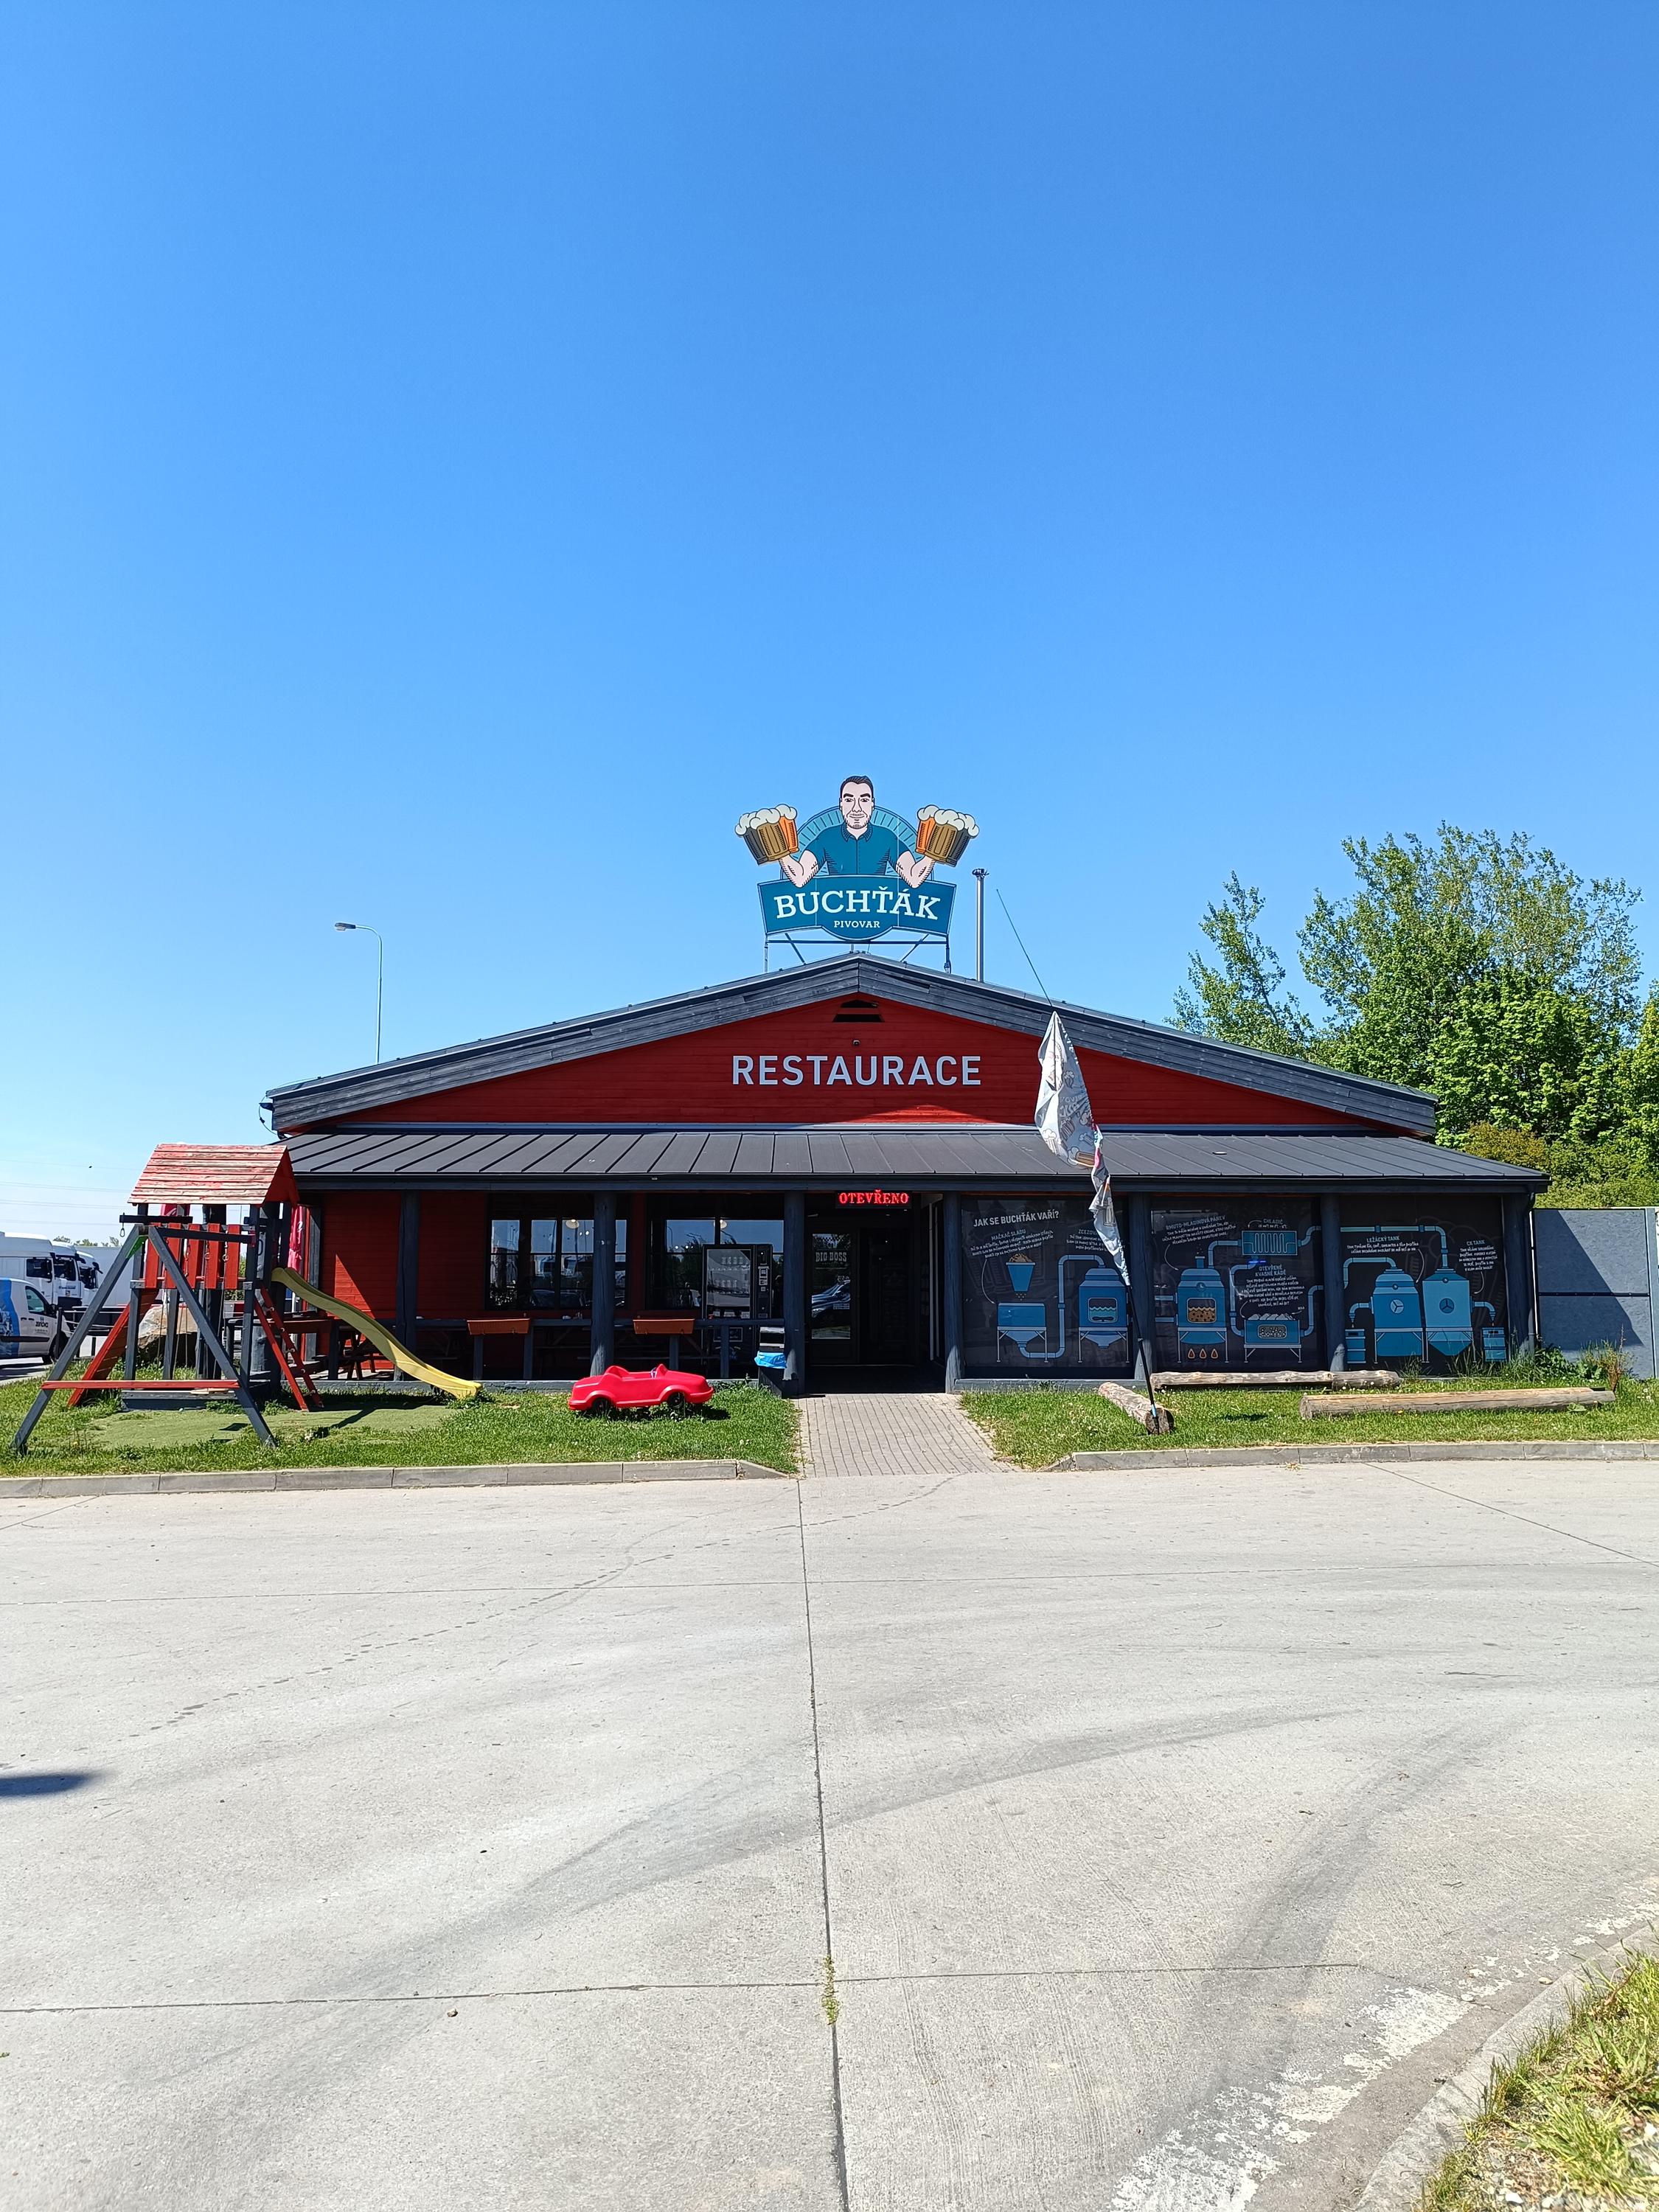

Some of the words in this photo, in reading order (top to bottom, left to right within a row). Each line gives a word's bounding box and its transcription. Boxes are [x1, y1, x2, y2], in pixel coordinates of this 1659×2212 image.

[773, 886, 941, 921] BUCHŤÁK
[833, 919, 880, 929] PIVOVAR
[732, 1055, 982, 1086] RESTAURACE
[838, 1189, 909, 1204] OTEVŘENO
[973, 1218, 989, 1228] JAK
[990, 1217, 1000, 1225] SE
[1001, 1211, 1037, 1224] BUCHŤÁK
[1037, 1208, 1060, 1221] VAŘÍ?
[815, 1251, 828, 1262] BIG
[830, 1251, 847, 1262] BOSS
